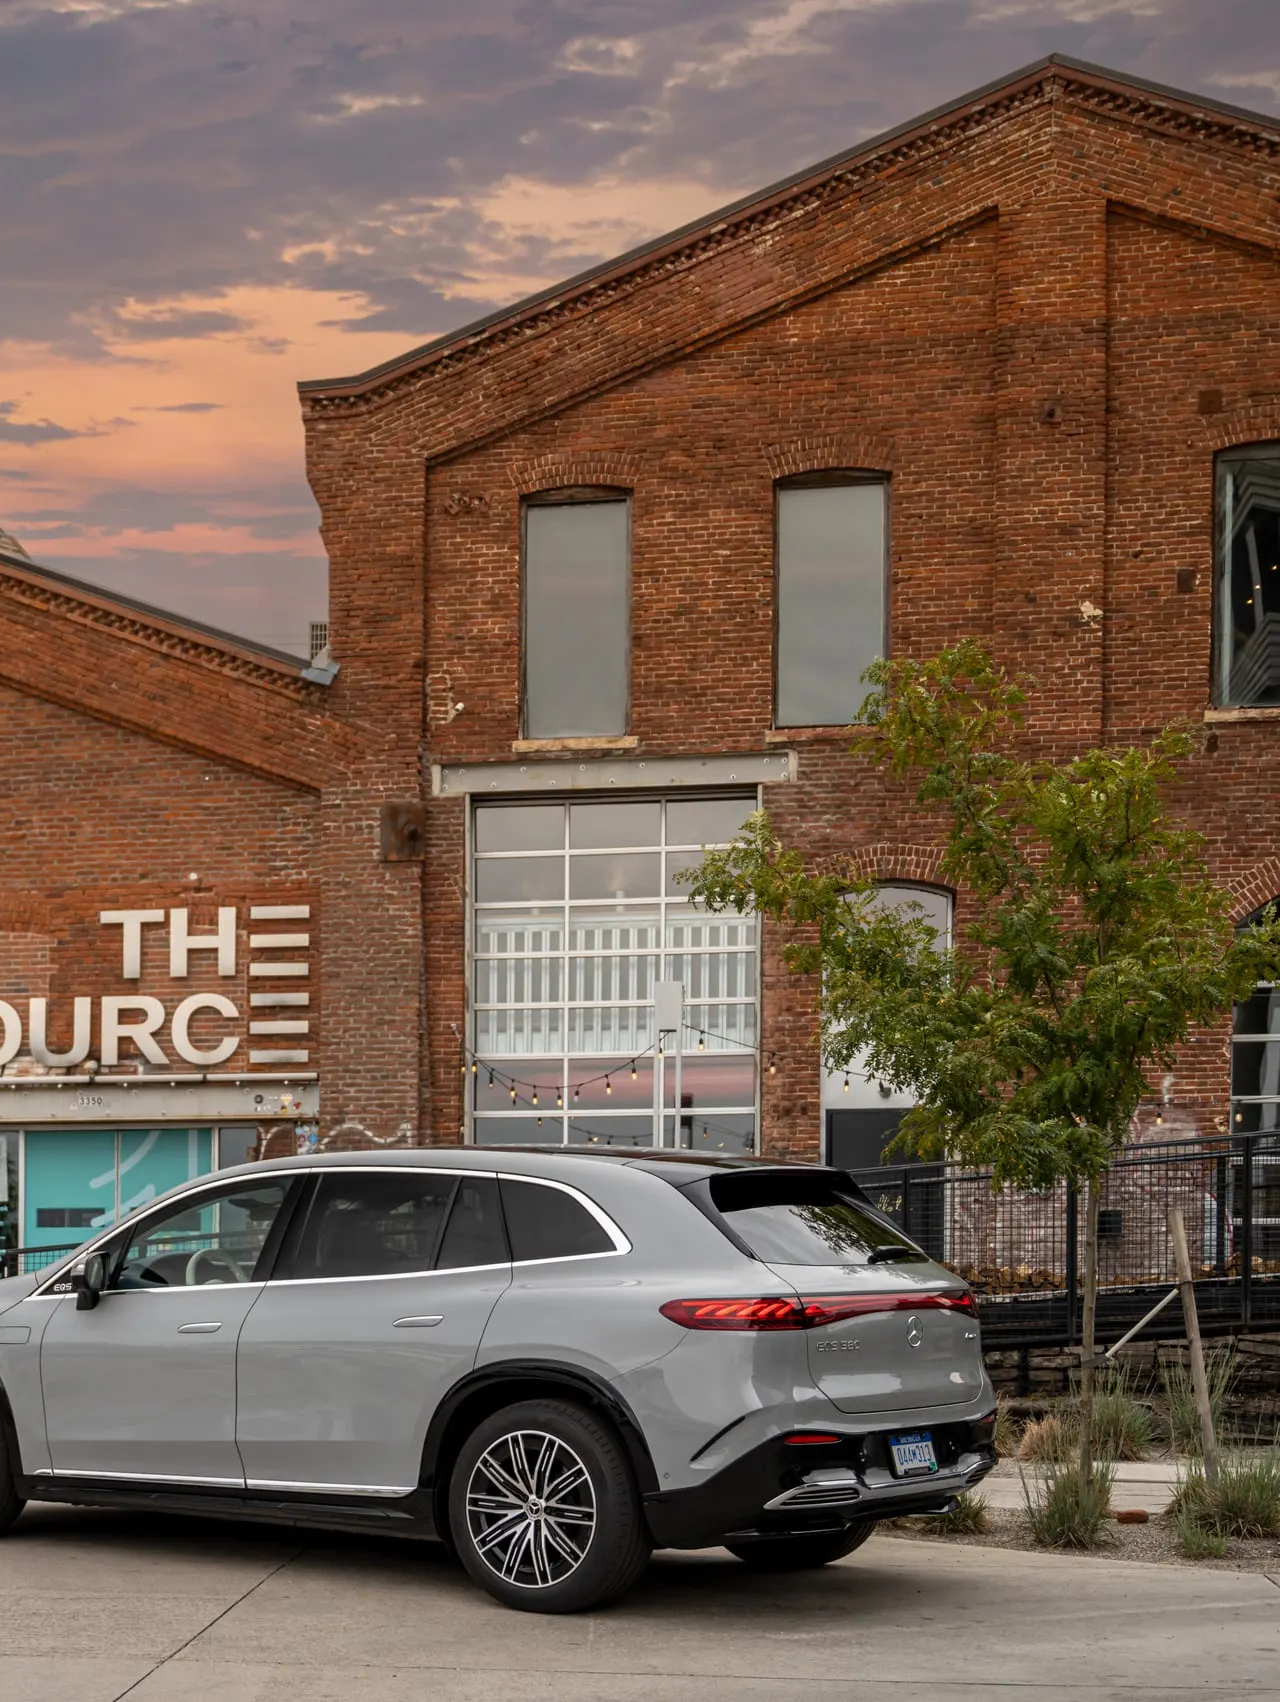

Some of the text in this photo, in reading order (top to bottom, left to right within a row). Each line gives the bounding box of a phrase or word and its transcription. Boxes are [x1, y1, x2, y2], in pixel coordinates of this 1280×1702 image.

[100, 905, 310, 979] THE
[80, 1096, 103, 1106] 3350
[54, 1283, 72, 1291] EQS
[816, 1341, 838, 1351] EQS
